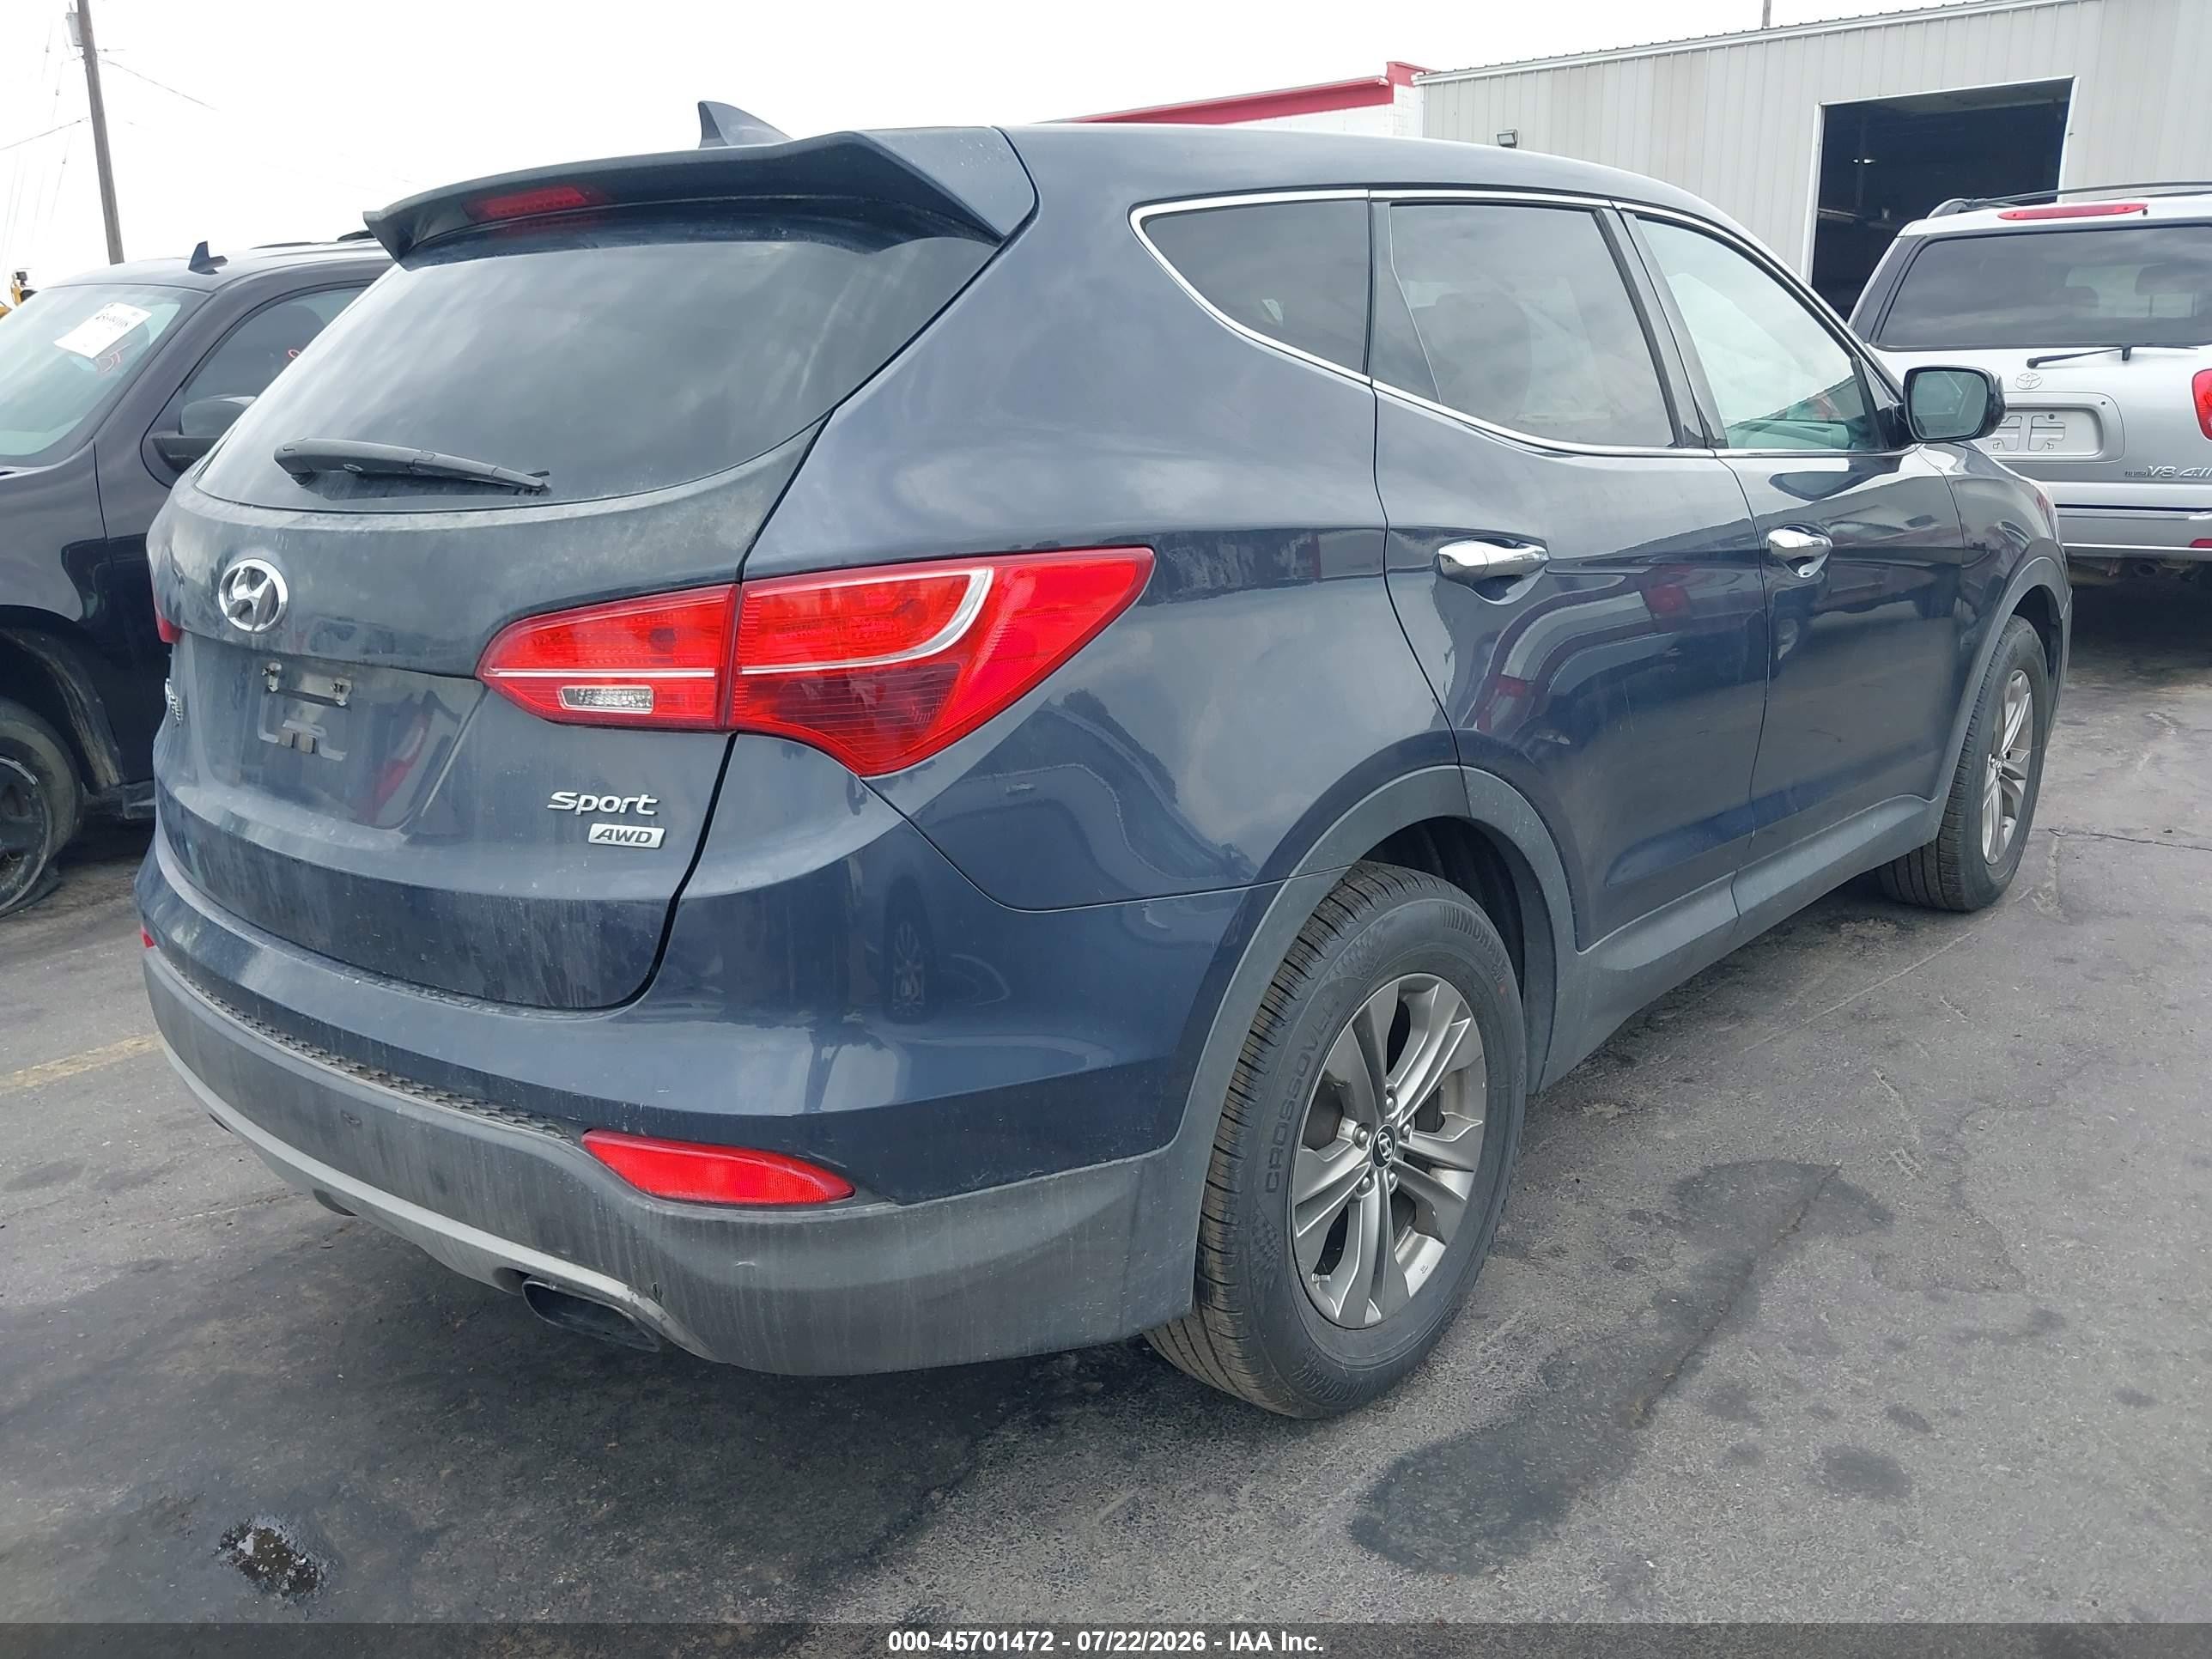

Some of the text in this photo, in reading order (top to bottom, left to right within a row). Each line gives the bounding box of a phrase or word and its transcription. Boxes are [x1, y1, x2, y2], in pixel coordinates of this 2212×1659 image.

[2147, 465, 2178, 477] V8
[547, 790, 659, 816] Sport
[595, 828, 653, 843] AWD
